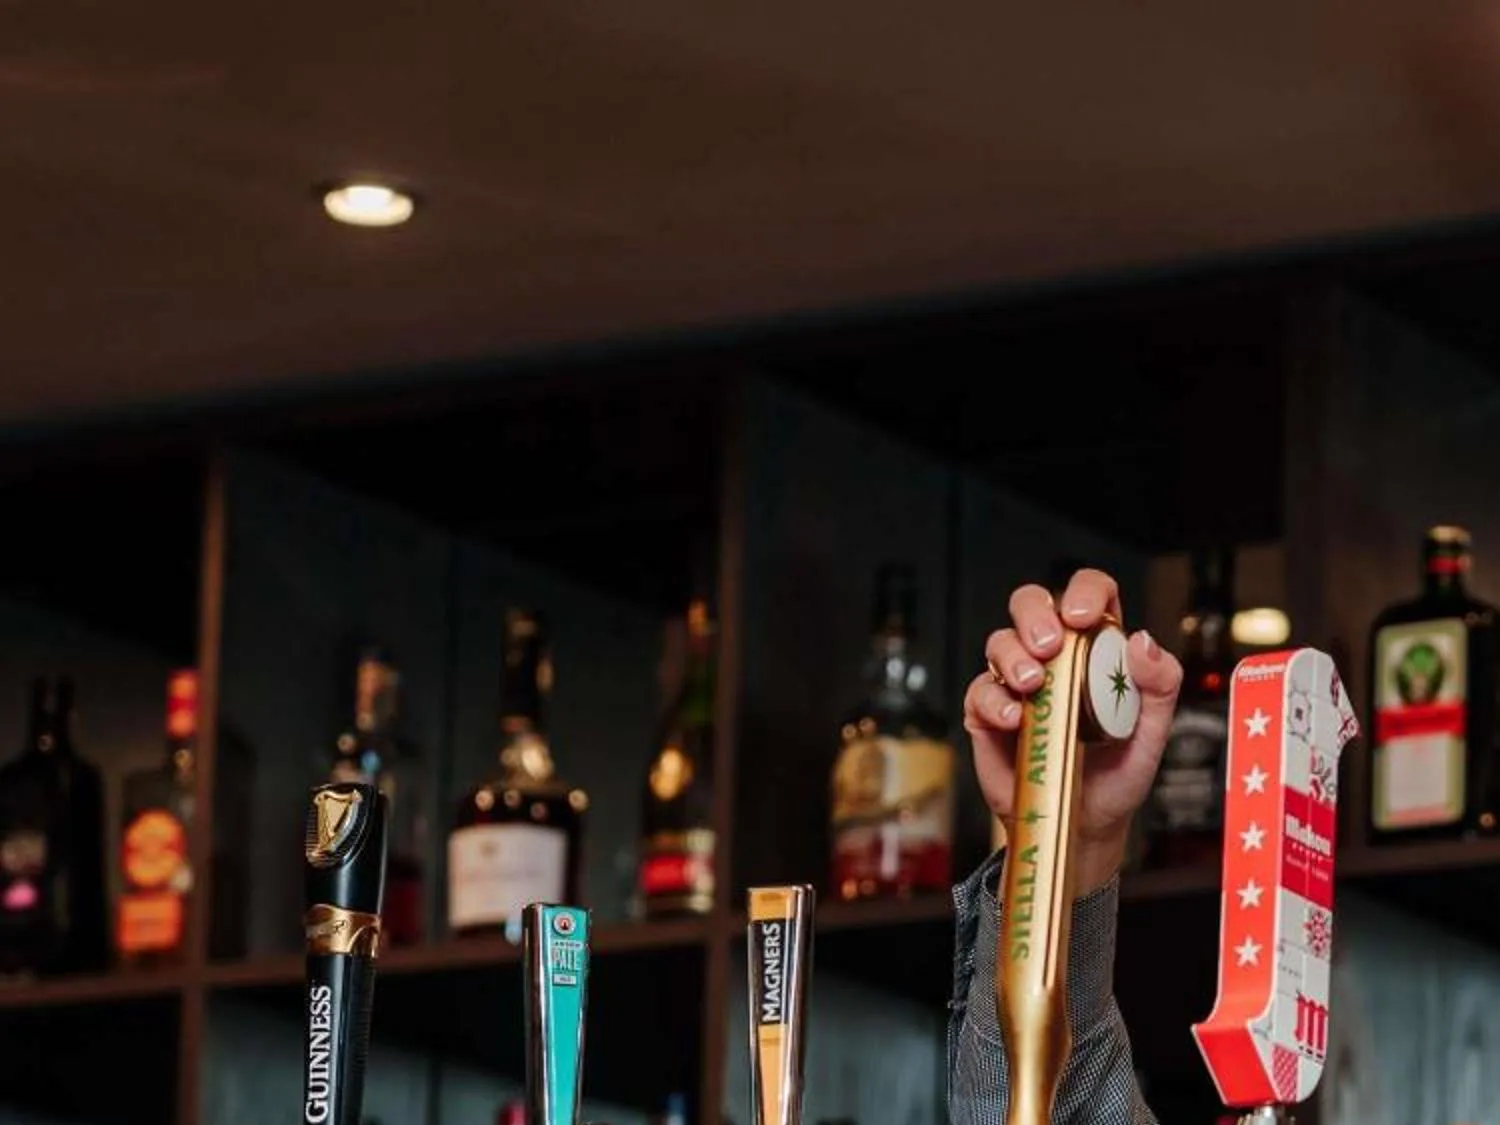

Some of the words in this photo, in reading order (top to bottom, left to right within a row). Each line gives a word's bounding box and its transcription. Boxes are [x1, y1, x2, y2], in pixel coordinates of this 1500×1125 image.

[1011, 844, 1039, 961] STELLA
[762, 922, 782, 1023] MAGNERS
[305, 985, 332, 1125] GUINNESS
